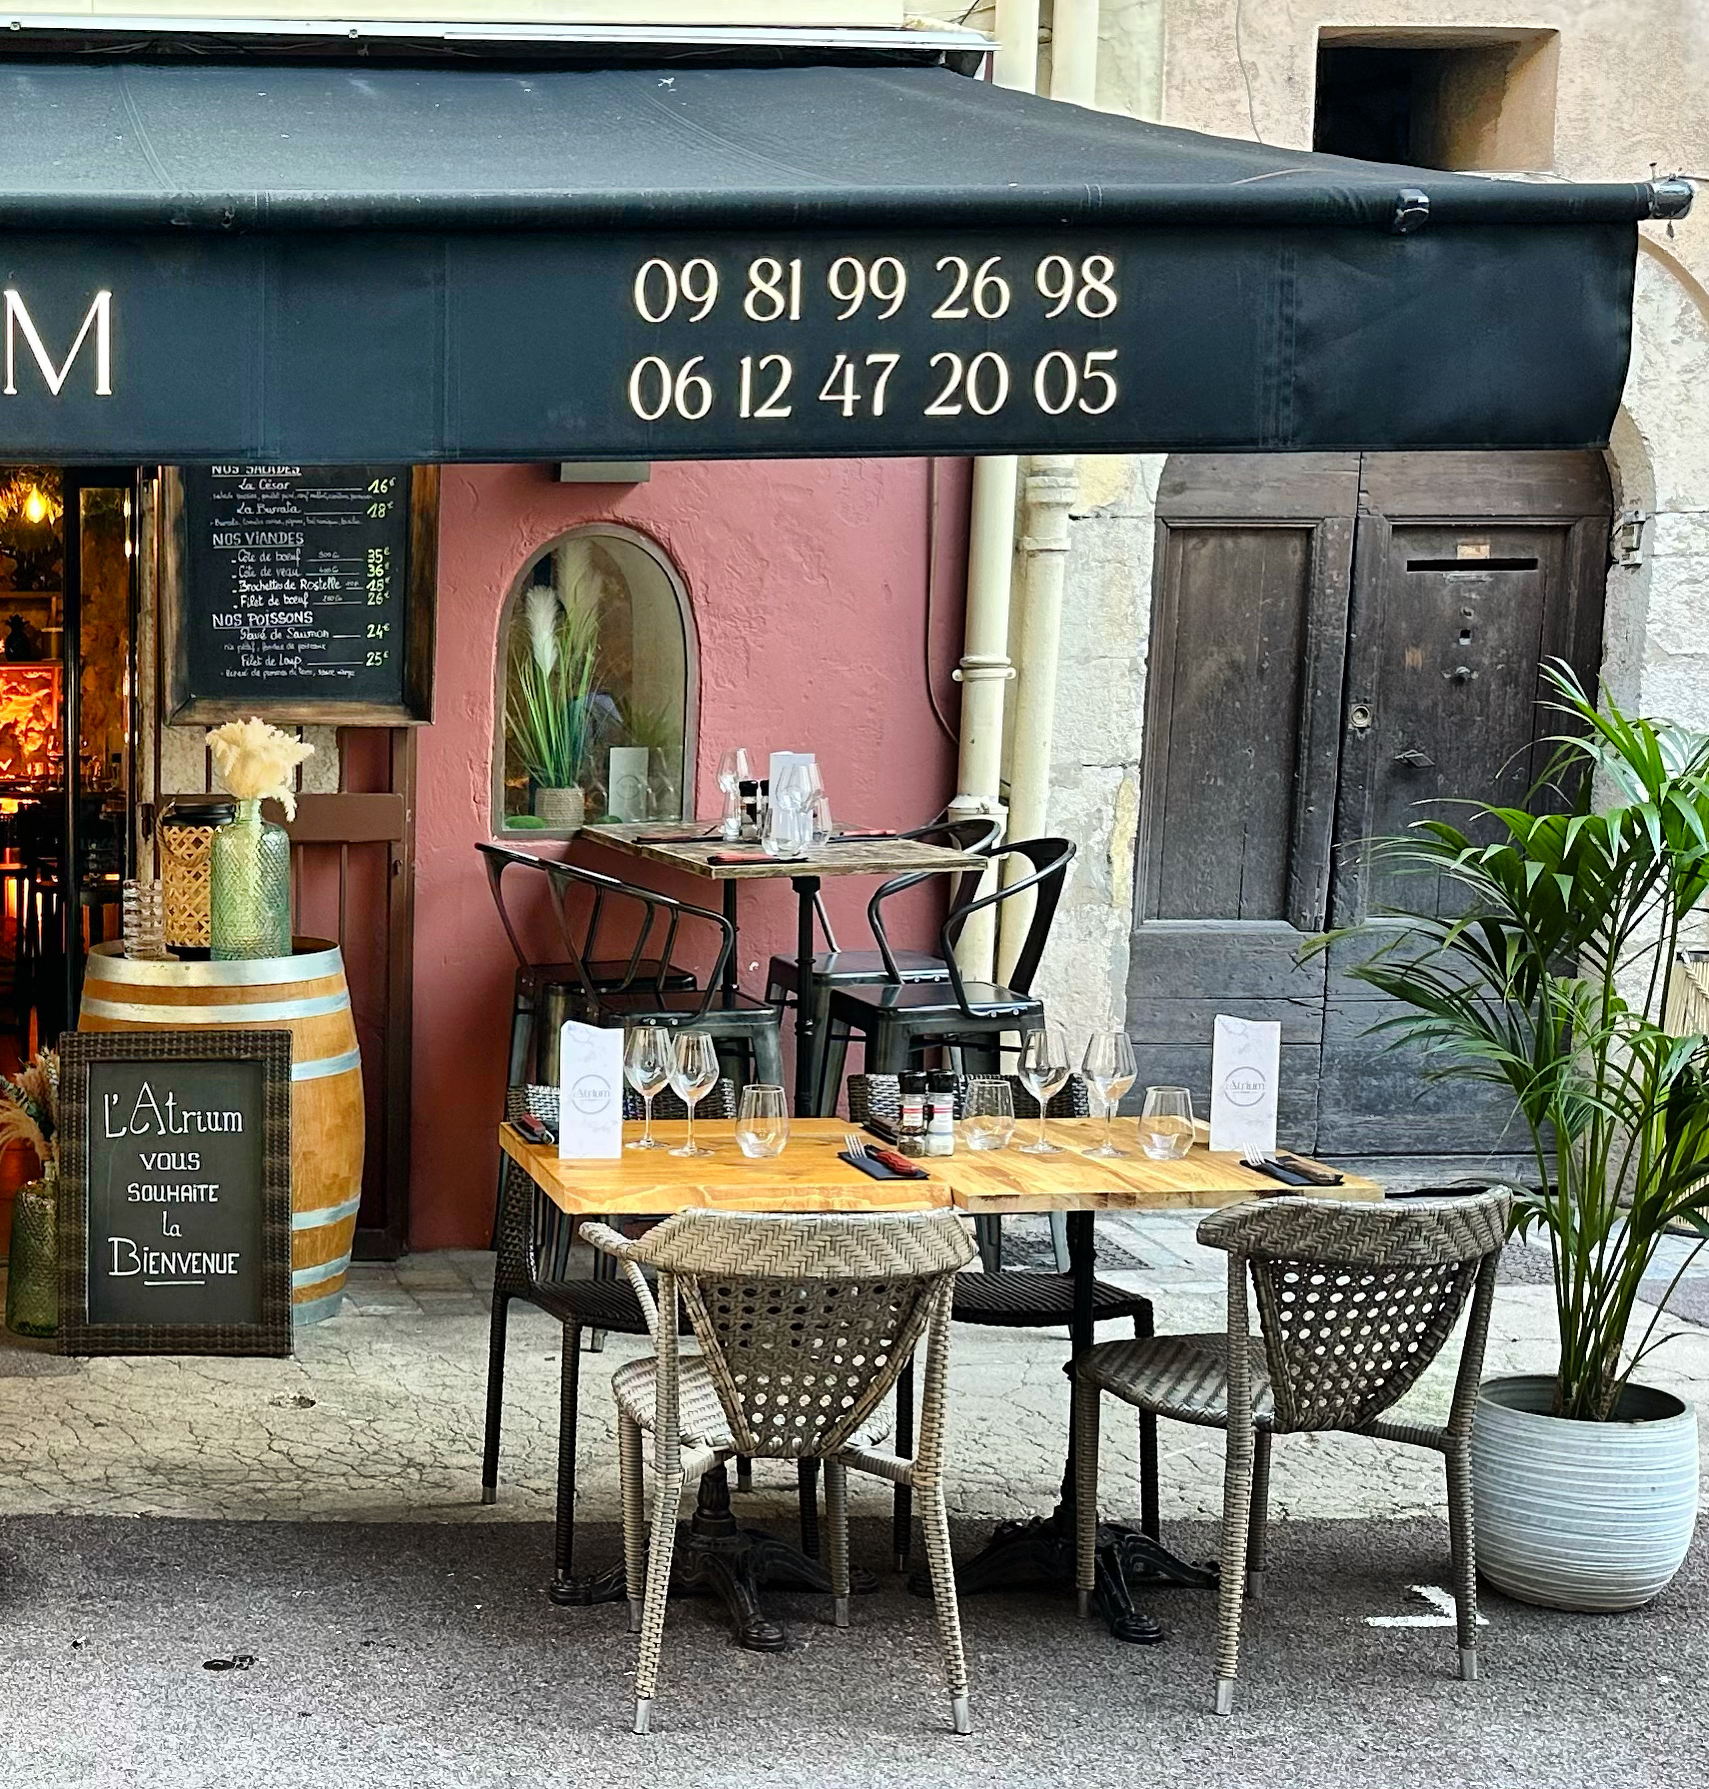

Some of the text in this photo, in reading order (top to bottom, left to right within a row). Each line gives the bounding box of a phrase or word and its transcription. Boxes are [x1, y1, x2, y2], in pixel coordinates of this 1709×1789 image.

[634, 255, 1118, 323] 09 81 99 26 98
[629, 349, 1118, 421] 06 12 47 20 05
[238, 478, 255, 490] La
[236, 501, 254, 514] La
[212, 533, 241, 546] NOS
[260, 550, 271, 562] de
[260, 566, 272, 578] de
[276, 566, 302, 578] veau
[284, 578, 296, 591] de
[268, 594, 280, 606] de
[212, 613, 242, 627] NOS
[270, 627, 282, 640] de
[286, 628, 329, 640] Saumon
[265, 655, 277, 666] de
[103, 1081, 244, 1138] L'Atrium
[162, 1211, 183, 1237] la
